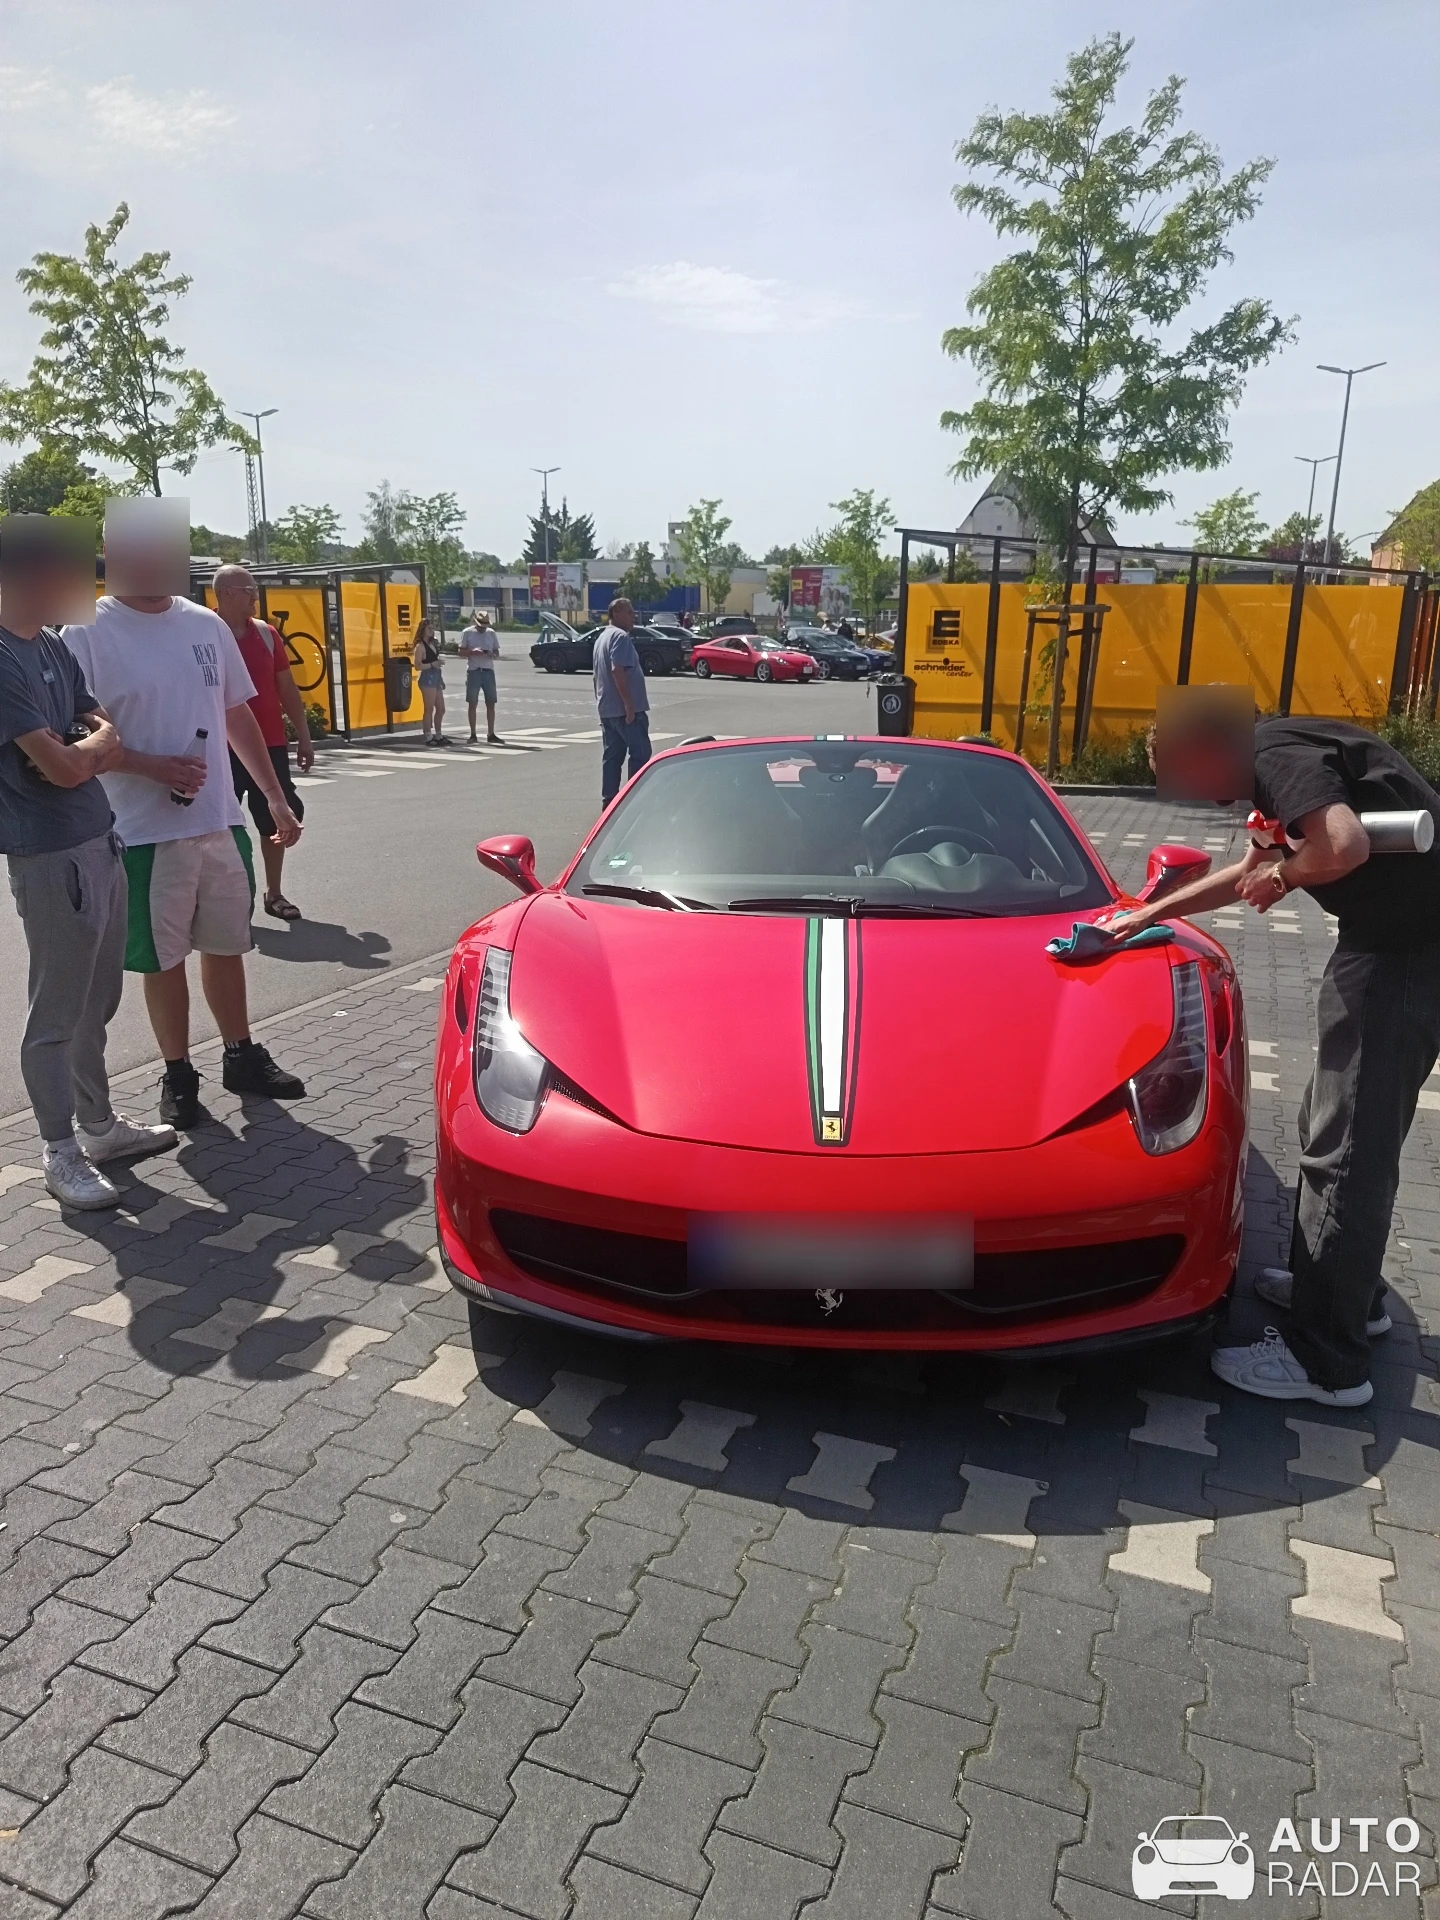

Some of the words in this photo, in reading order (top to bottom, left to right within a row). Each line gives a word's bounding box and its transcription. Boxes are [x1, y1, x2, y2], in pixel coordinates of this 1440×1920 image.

[932, 610, 961, 638] E
[913, 662, 966, 672] schneider
[945, 670, 974, 678] center
